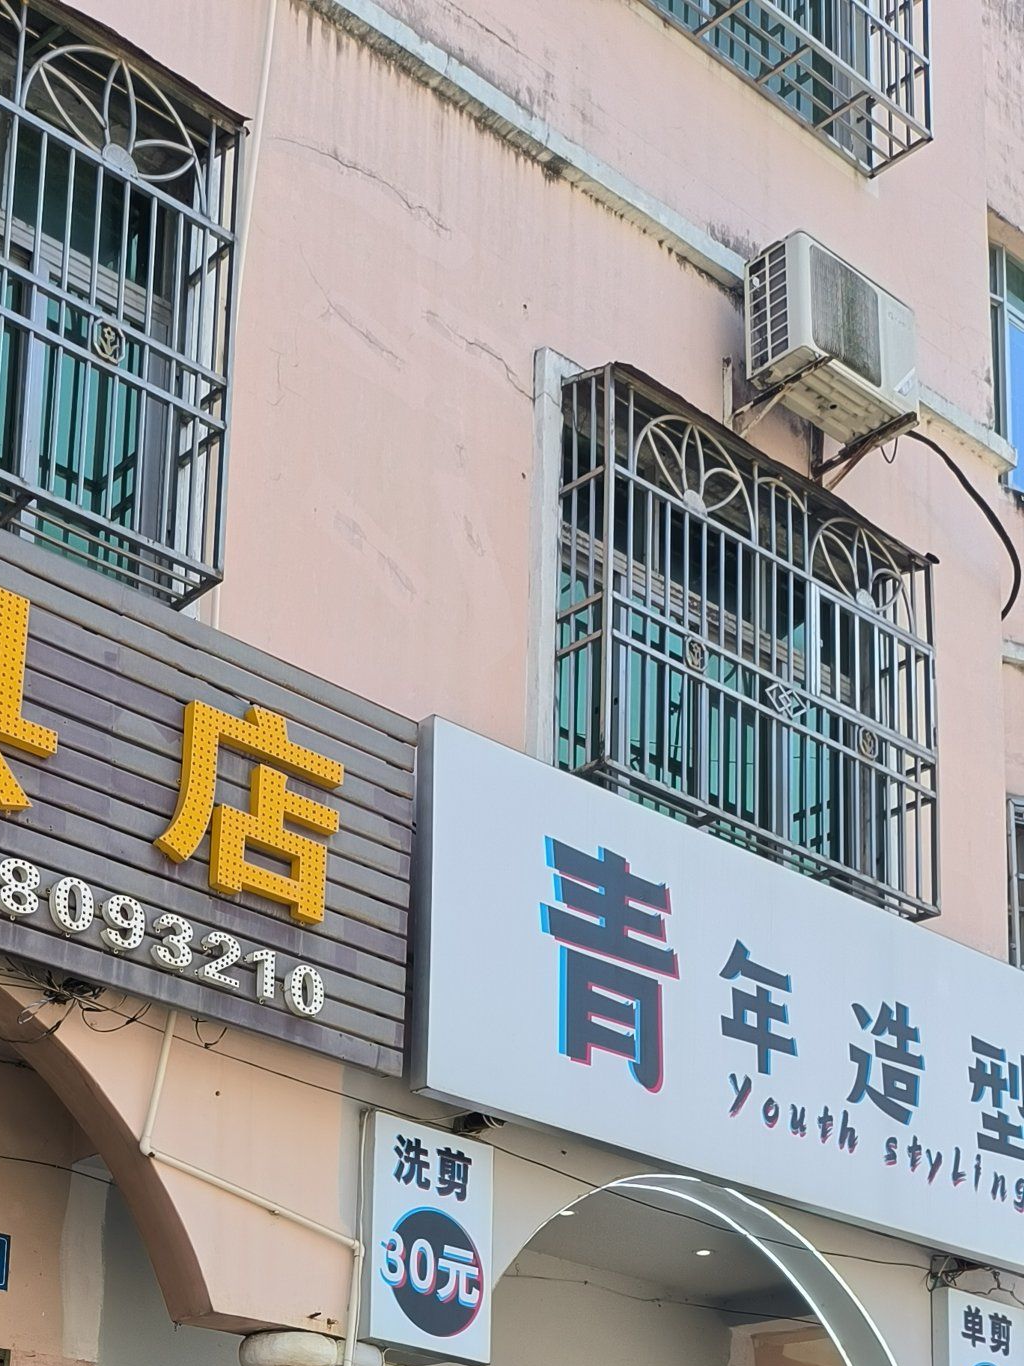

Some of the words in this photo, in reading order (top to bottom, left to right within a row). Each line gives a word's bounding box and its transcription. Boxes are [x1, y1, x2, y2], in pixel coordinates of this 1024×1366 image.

[539, 835, 1024, 1161] 青年造型
[729, 1072, 859, 1154] youth
[393, 1134, 473, 1202] 洗剪
[380, 1231, 480, 1308] 30元
[961, 1304, 1012, 1357] 单剪
